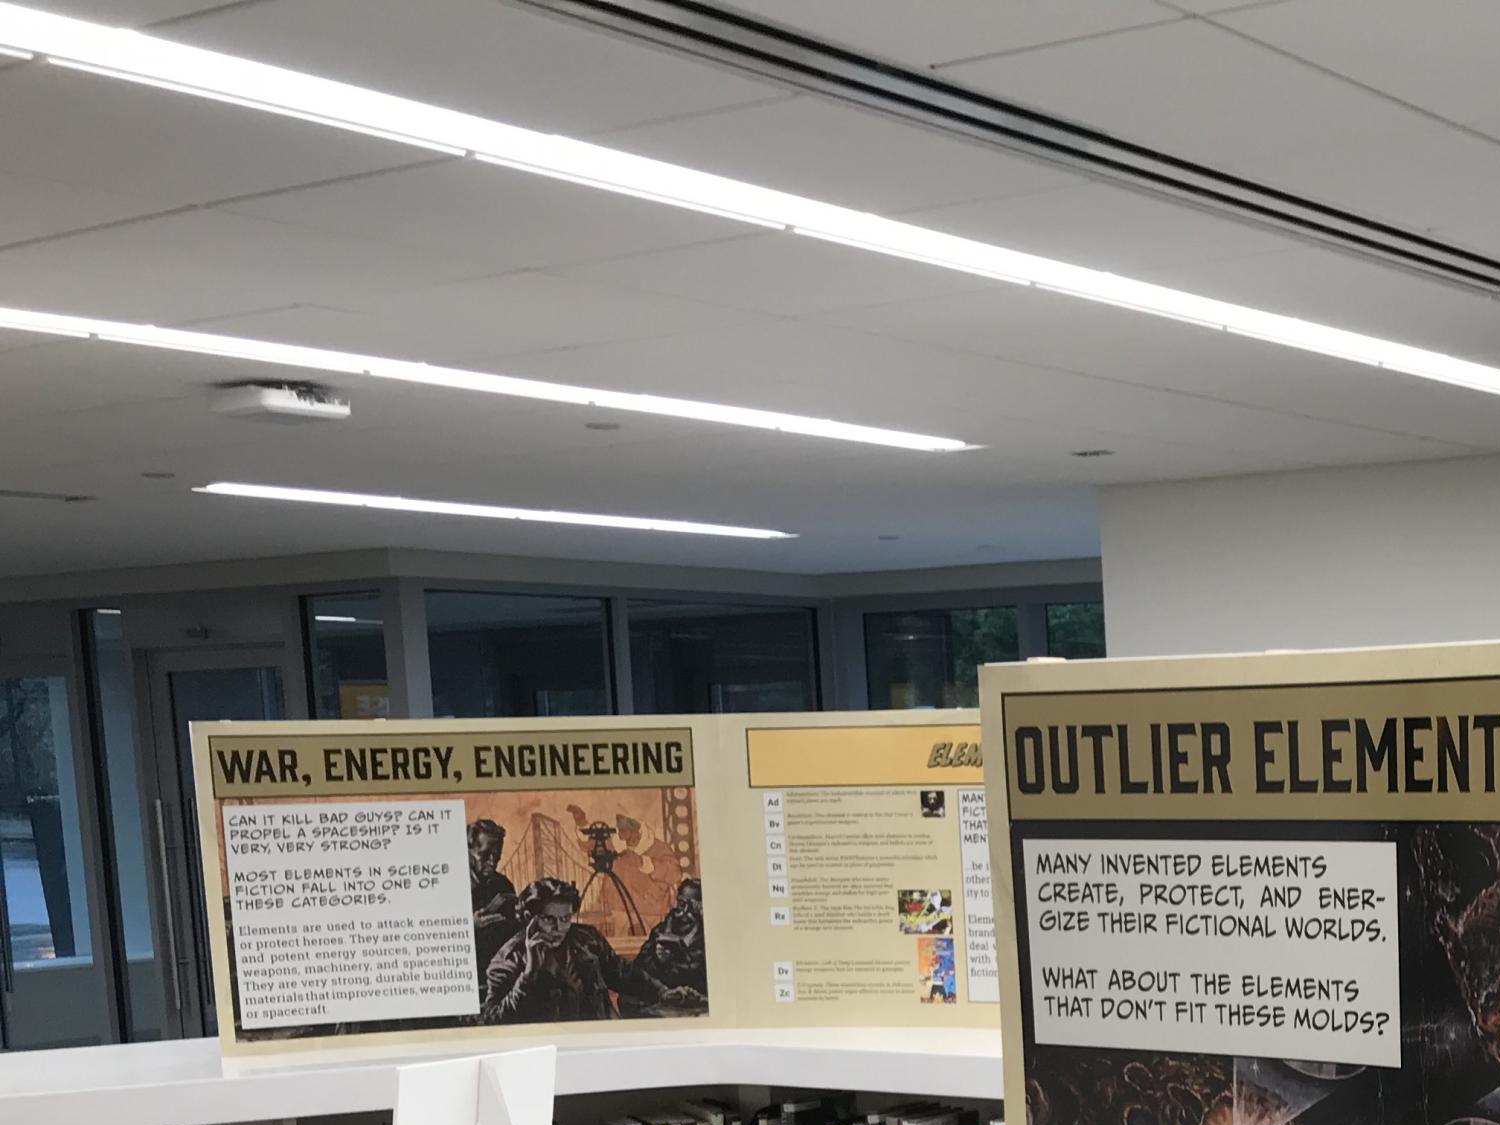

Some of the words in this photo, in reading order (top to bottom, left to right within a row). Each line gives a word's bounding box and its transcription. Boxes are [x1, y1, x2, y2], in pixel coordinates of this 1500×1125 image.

[217, 749, 312, 787] WAR,
[323, 746, 462, 784] ENERGY,
[474, 741, 684, 778] ENGINEERING
[1015, 721, 1232, 795] OUTLIER
[768, 798, 779, 807] Ad
[229, 816, 256, 827] CAN
[264, 815, 274, 825] IT
[282, 814, 312, 825] KILL
[320, 813, 348, 823] BAD
[355, 811, 402, 823] GUYS?
[409, 810, 434, 821] CAN
[441, 810, 452, 820] IT
[231, 827, 290, 840] PROPEL
[297, 827, 306, 838] A
[312, 824, 400, 838] SPACESHIP?
[406, 824, 422, 835] IS
[428, 824, 439, 834] IT
[231, 842, 271, 855] VERY,
[277, 841, 314, 853] VERY
[321, 839, 391, 851] STRONG?
[234, 871, 277, 883] MOST
[285, 867, 362, 880] ELEMENTS
[369, 867, 381, 877] IN
[388, 864, 449, 876] SCIENCE
[1036, 853, 1091, 875] MANY
[1101, 854, 1201, 876] INVENTED
[1212, 854, 1327, 878] ELEMENTS
[236, 884, 294, 896] FICTION
[302, 882, 336, 894] FALL
[344, 881, 375, 892] INTO
[382, 879, 411, 890] ONE
[419, 877, 439, 888] OF
[1038, 882, 1124, 906] CREATE,
[1139, 883, 1245, 909] PROTECT,
[1260, 885, 1302, 908] AND
[1319, 887, 1385, 910] ENER-
[236, 898, 284, 910] THESE
[292, 893, 391, 908] CATEGORIES.
[1039, 911, 1090, 931] GIZE
[1097, 912, 1157, 934] THEIR
[1165, 913, 1277, 938] FICTIONAL
[1285, 916, 1386, 942] WORLDS.
[244, 981, 274, 992] They
[279, 980, 297, 989] are
[302, 978, 327, 989] very
[376, 972, 420, 983] durable
[424, 970, 472, 981] building
[1042, 966, 1098, 989] WHAT
[1108, 969, 1180, 993] ABOUT
[1190, 973, 1231, 995] THE
[1242, 975, 1359, 1002] ELEMENTS
[1044, 996, 1093, 1018] THAT
[1101, 998, 1167, 1021] DON'T
[1175, 1002, 1207, 1023] FIT
[1215, 1004, 1285, 1027] THESE
[1294, 1008, 1390, 1036] MOLDS?
